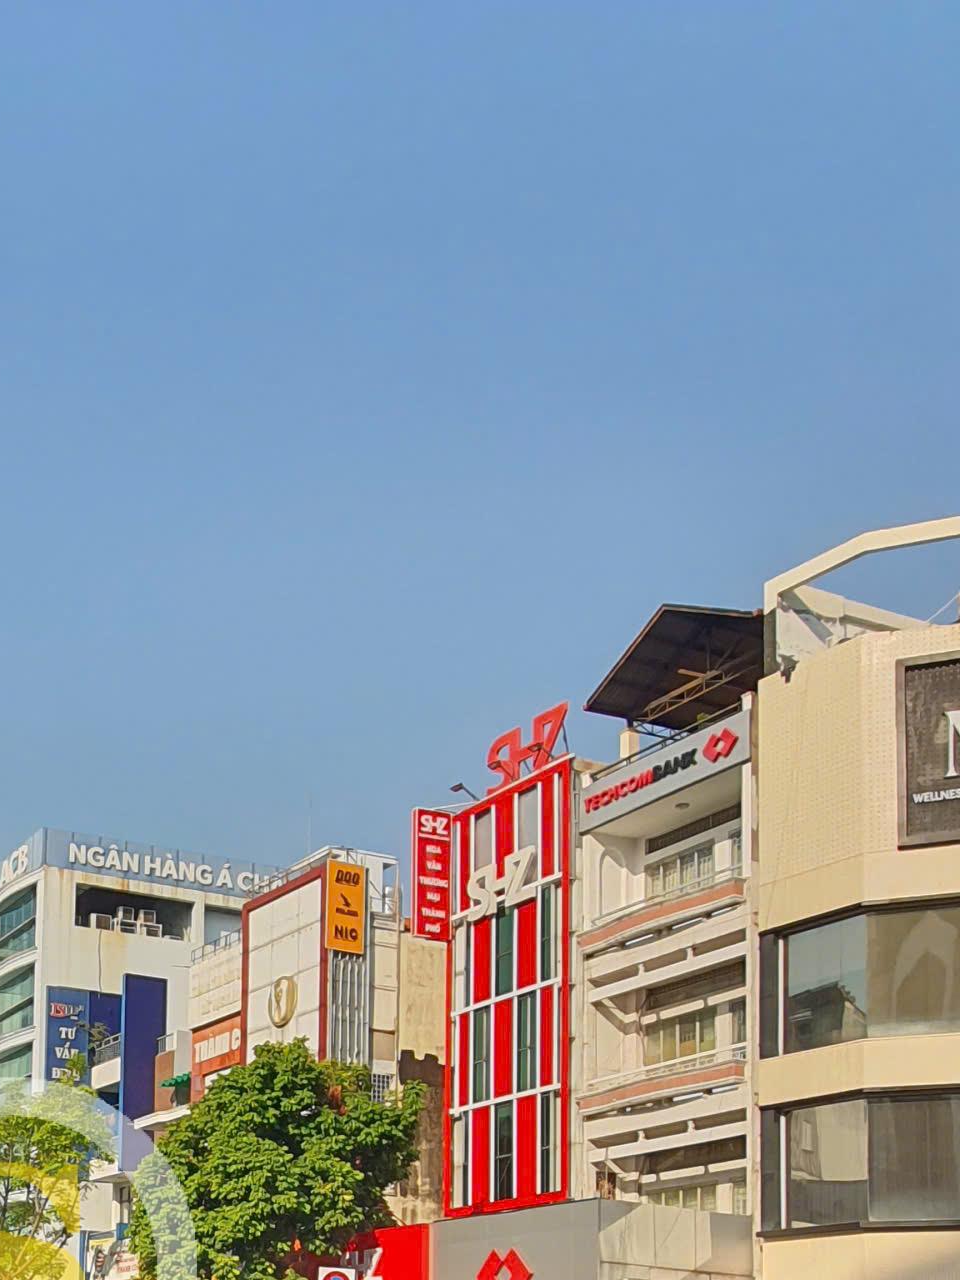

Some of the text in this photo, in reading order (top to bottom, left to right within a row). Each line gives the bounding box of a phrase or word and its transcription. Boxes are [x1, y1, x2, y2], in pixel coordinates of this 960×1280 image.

[486, 700, 568, 796] SHZ
[584, 748, 698, 814] TECHCOMBANK
[419, 814, 449, 836] SHZ
[68, 842, 140, 874] NGÂN
[143, 854, 213, 886] HÀNG
[215, 863, 234, 890] Á
[467, 845, 537, 922] SHZ
